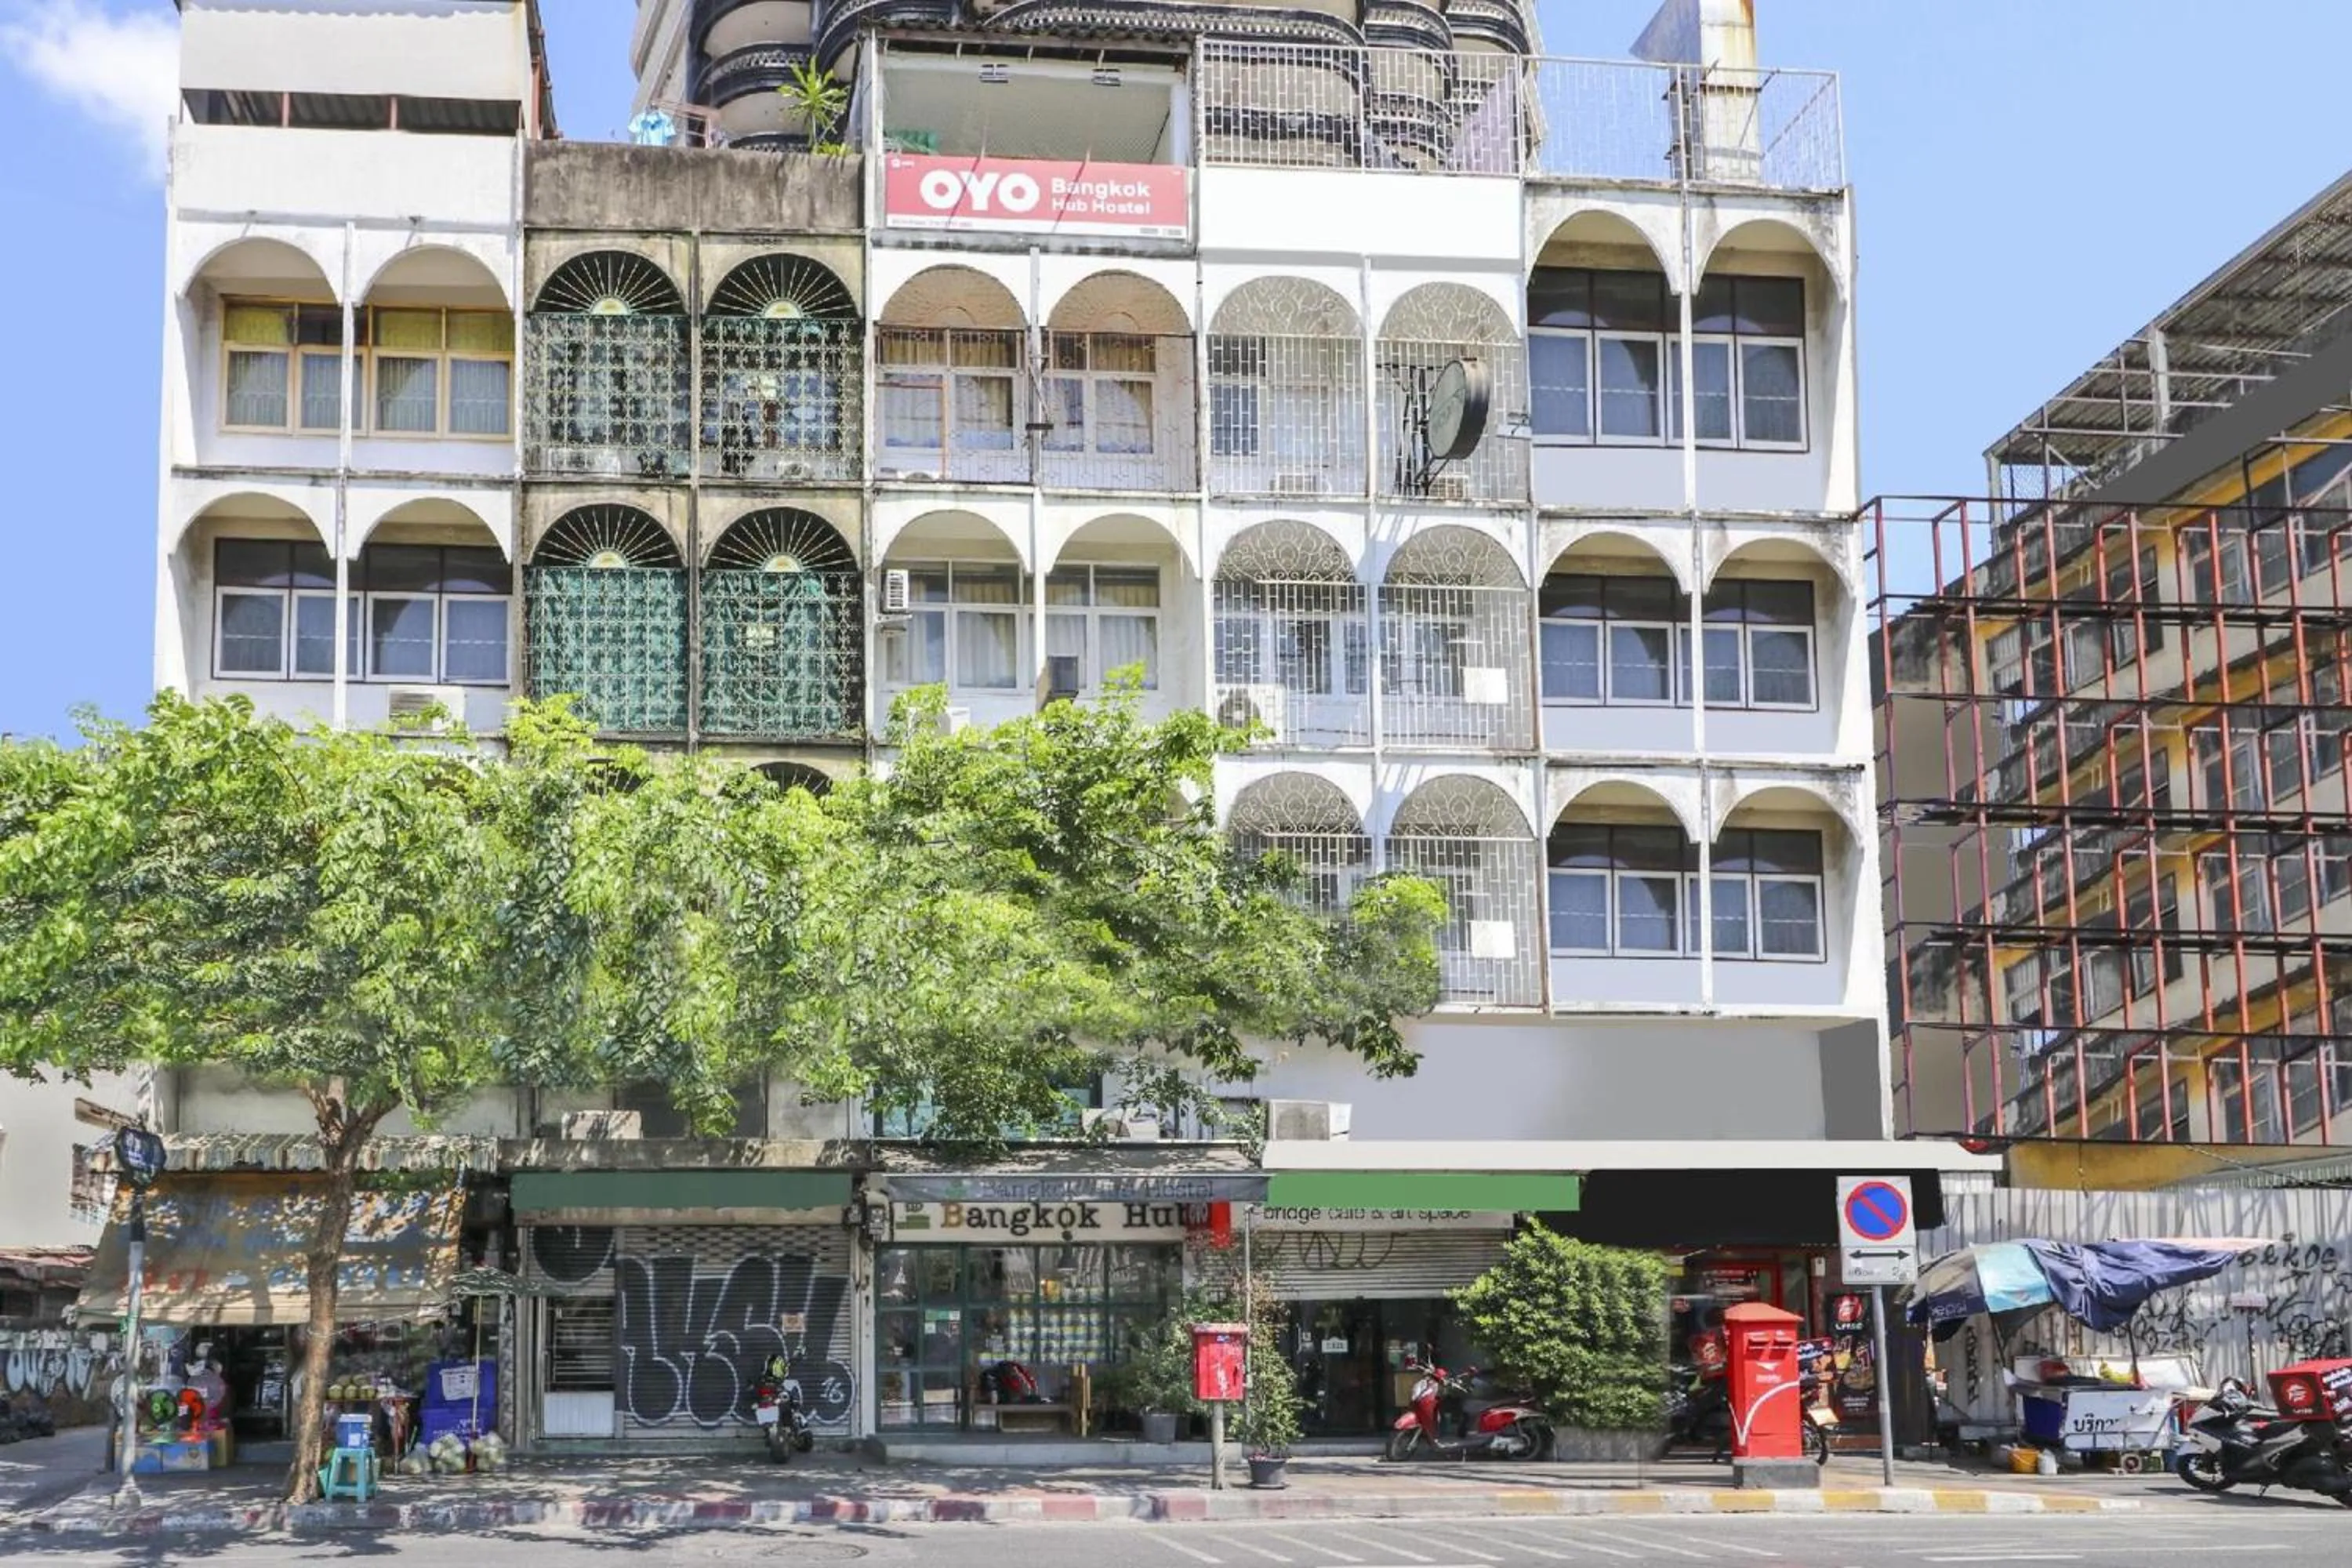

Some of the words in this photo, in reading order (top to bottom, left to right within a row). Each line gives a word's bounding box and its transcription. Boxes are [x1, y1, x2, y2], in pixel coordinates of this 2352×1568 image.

[920, 169, 1040, 212] OYO
[1051, 178, 1150, 201] Bangkok
[1052, 198, 1087, 212] Hub
[1092, 201, 1151, 215] Hostel
[941, 1201, 1101, 1236] Bangkok
